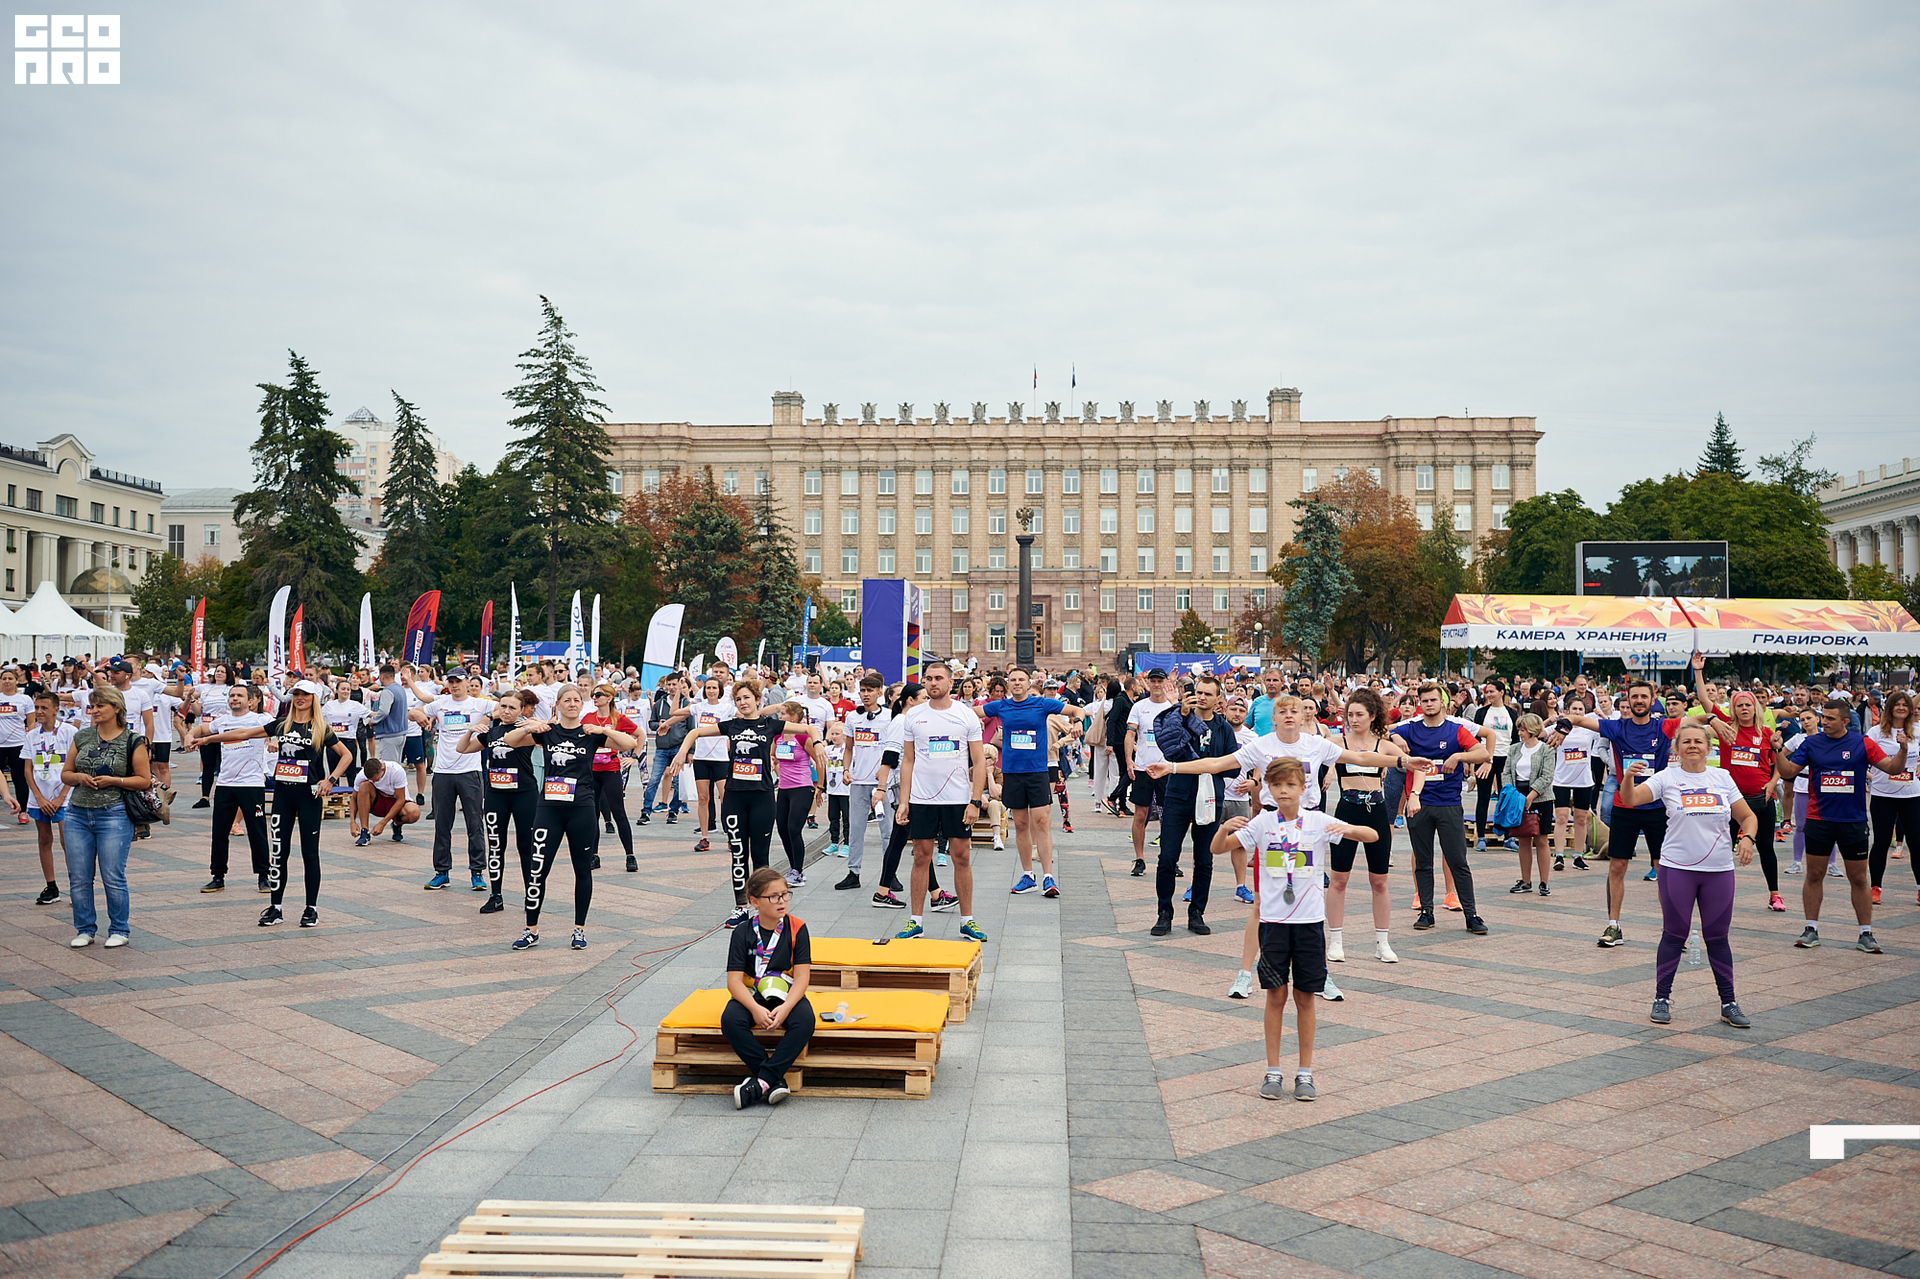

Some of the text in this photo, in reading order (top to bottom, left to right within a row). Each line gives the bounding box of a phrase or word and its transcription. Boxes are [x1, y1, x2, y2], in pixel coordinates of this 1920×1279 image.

[1441, 627, 1469, 639] РЕГИСТРАЦИЯ
[1496, 629, 1668, 642] КАМЕРА ХРАНЕНИЯ
[1752, 634, 1869, 646] ГРАВИРОВКА
[856, 732, 875, 740] 5127
[932, 742, 951, 751] 1018
[1732, 751, 1753, 760] 5441
[278, 766, 301, 775] 5560
[734, 764, 755, 773] 5561
[491, 774, 511, 782] 5562
[1822, 777, 1847, 785] 2034
[546, 784, 568, 792] 5563
[1685, 796, 1714, 805] 5133
[765, 976, 774, 988] 1
